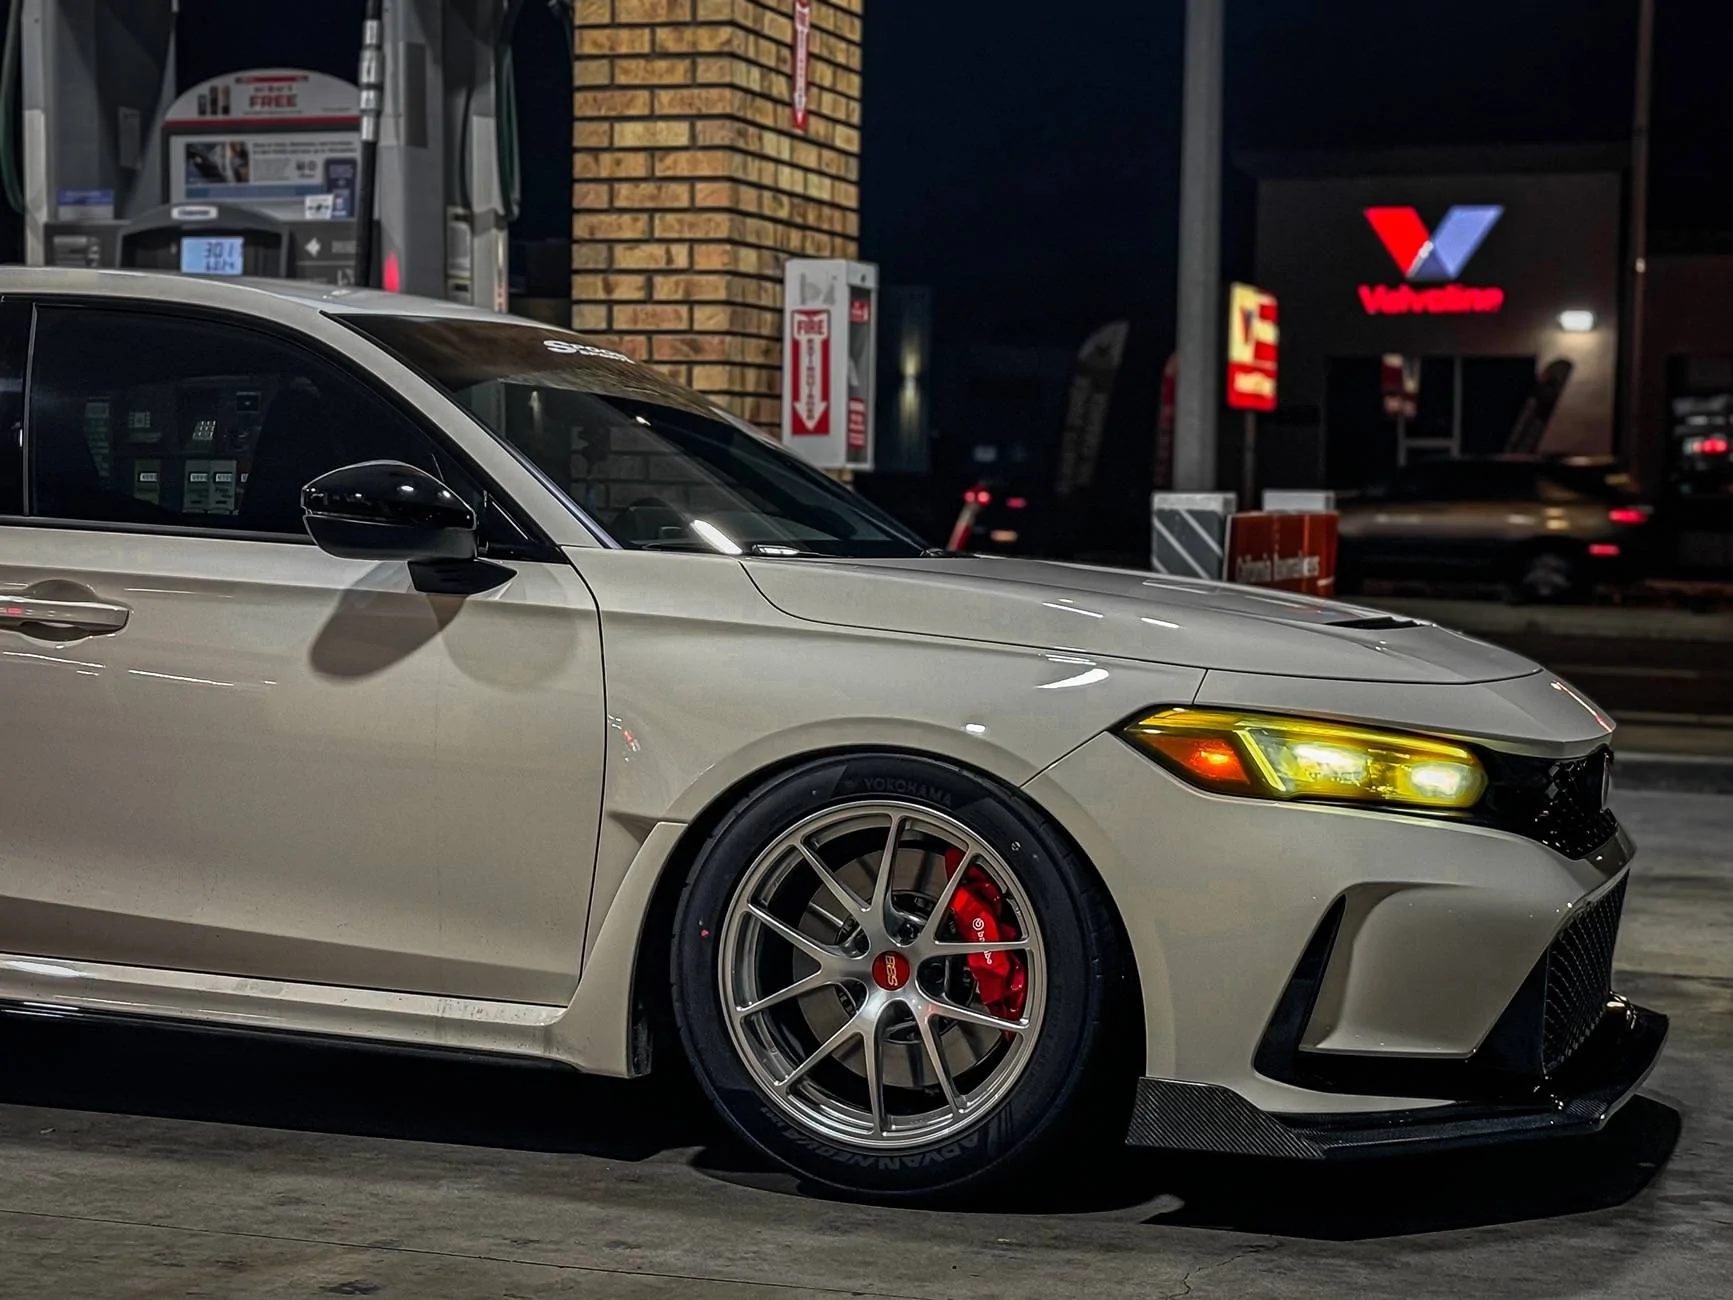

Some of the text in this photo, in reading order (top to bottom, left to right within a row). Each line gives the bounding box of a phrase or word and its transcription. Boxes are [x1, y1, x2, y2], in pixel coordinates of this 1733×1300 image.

[797, 320, 825, 335] FIRE
[864, 778, 953, 806] YOKOHAMA
[885, 955, 898, 986] BBS
